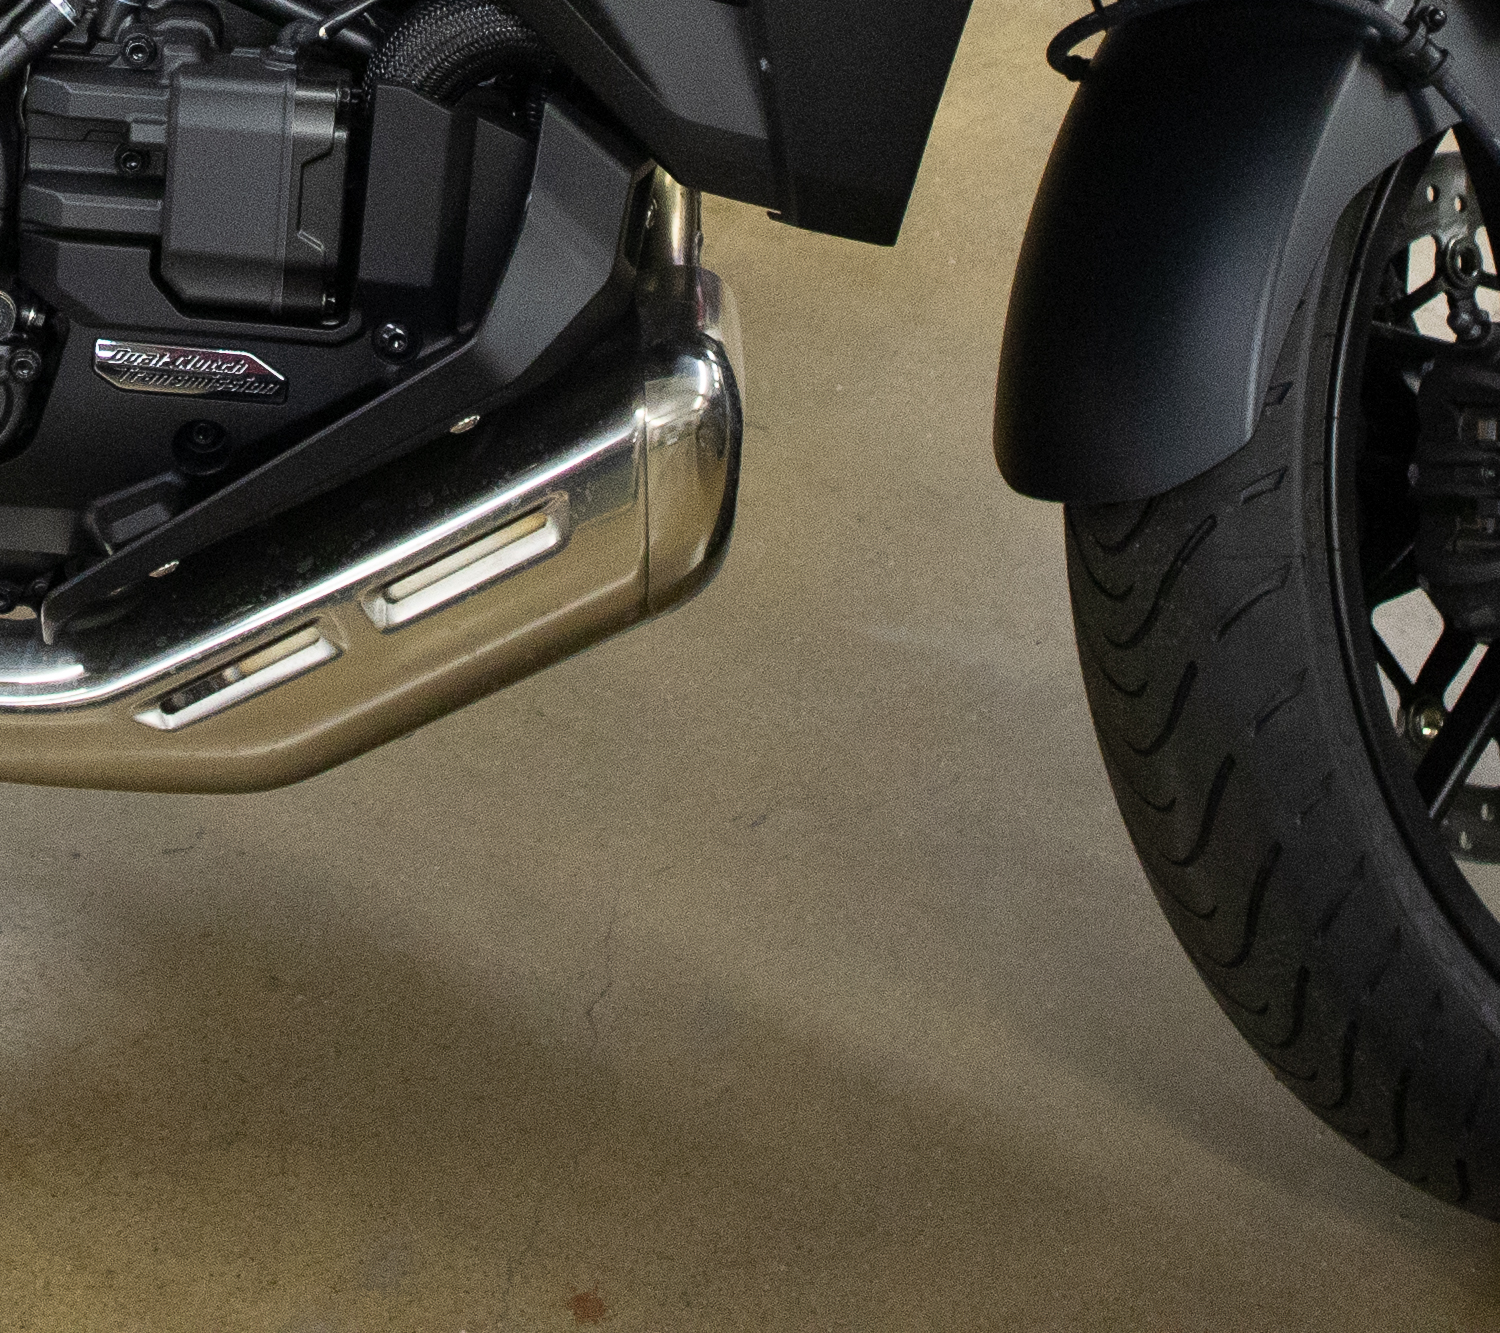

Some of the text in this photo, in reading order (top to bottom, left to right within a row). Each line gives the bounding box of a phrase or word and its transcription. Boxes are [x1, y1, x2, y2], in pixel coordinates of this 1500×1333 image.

[110, 349, 249, 375] Dual Clutch
[119, 367, 281, 395] Transmission
